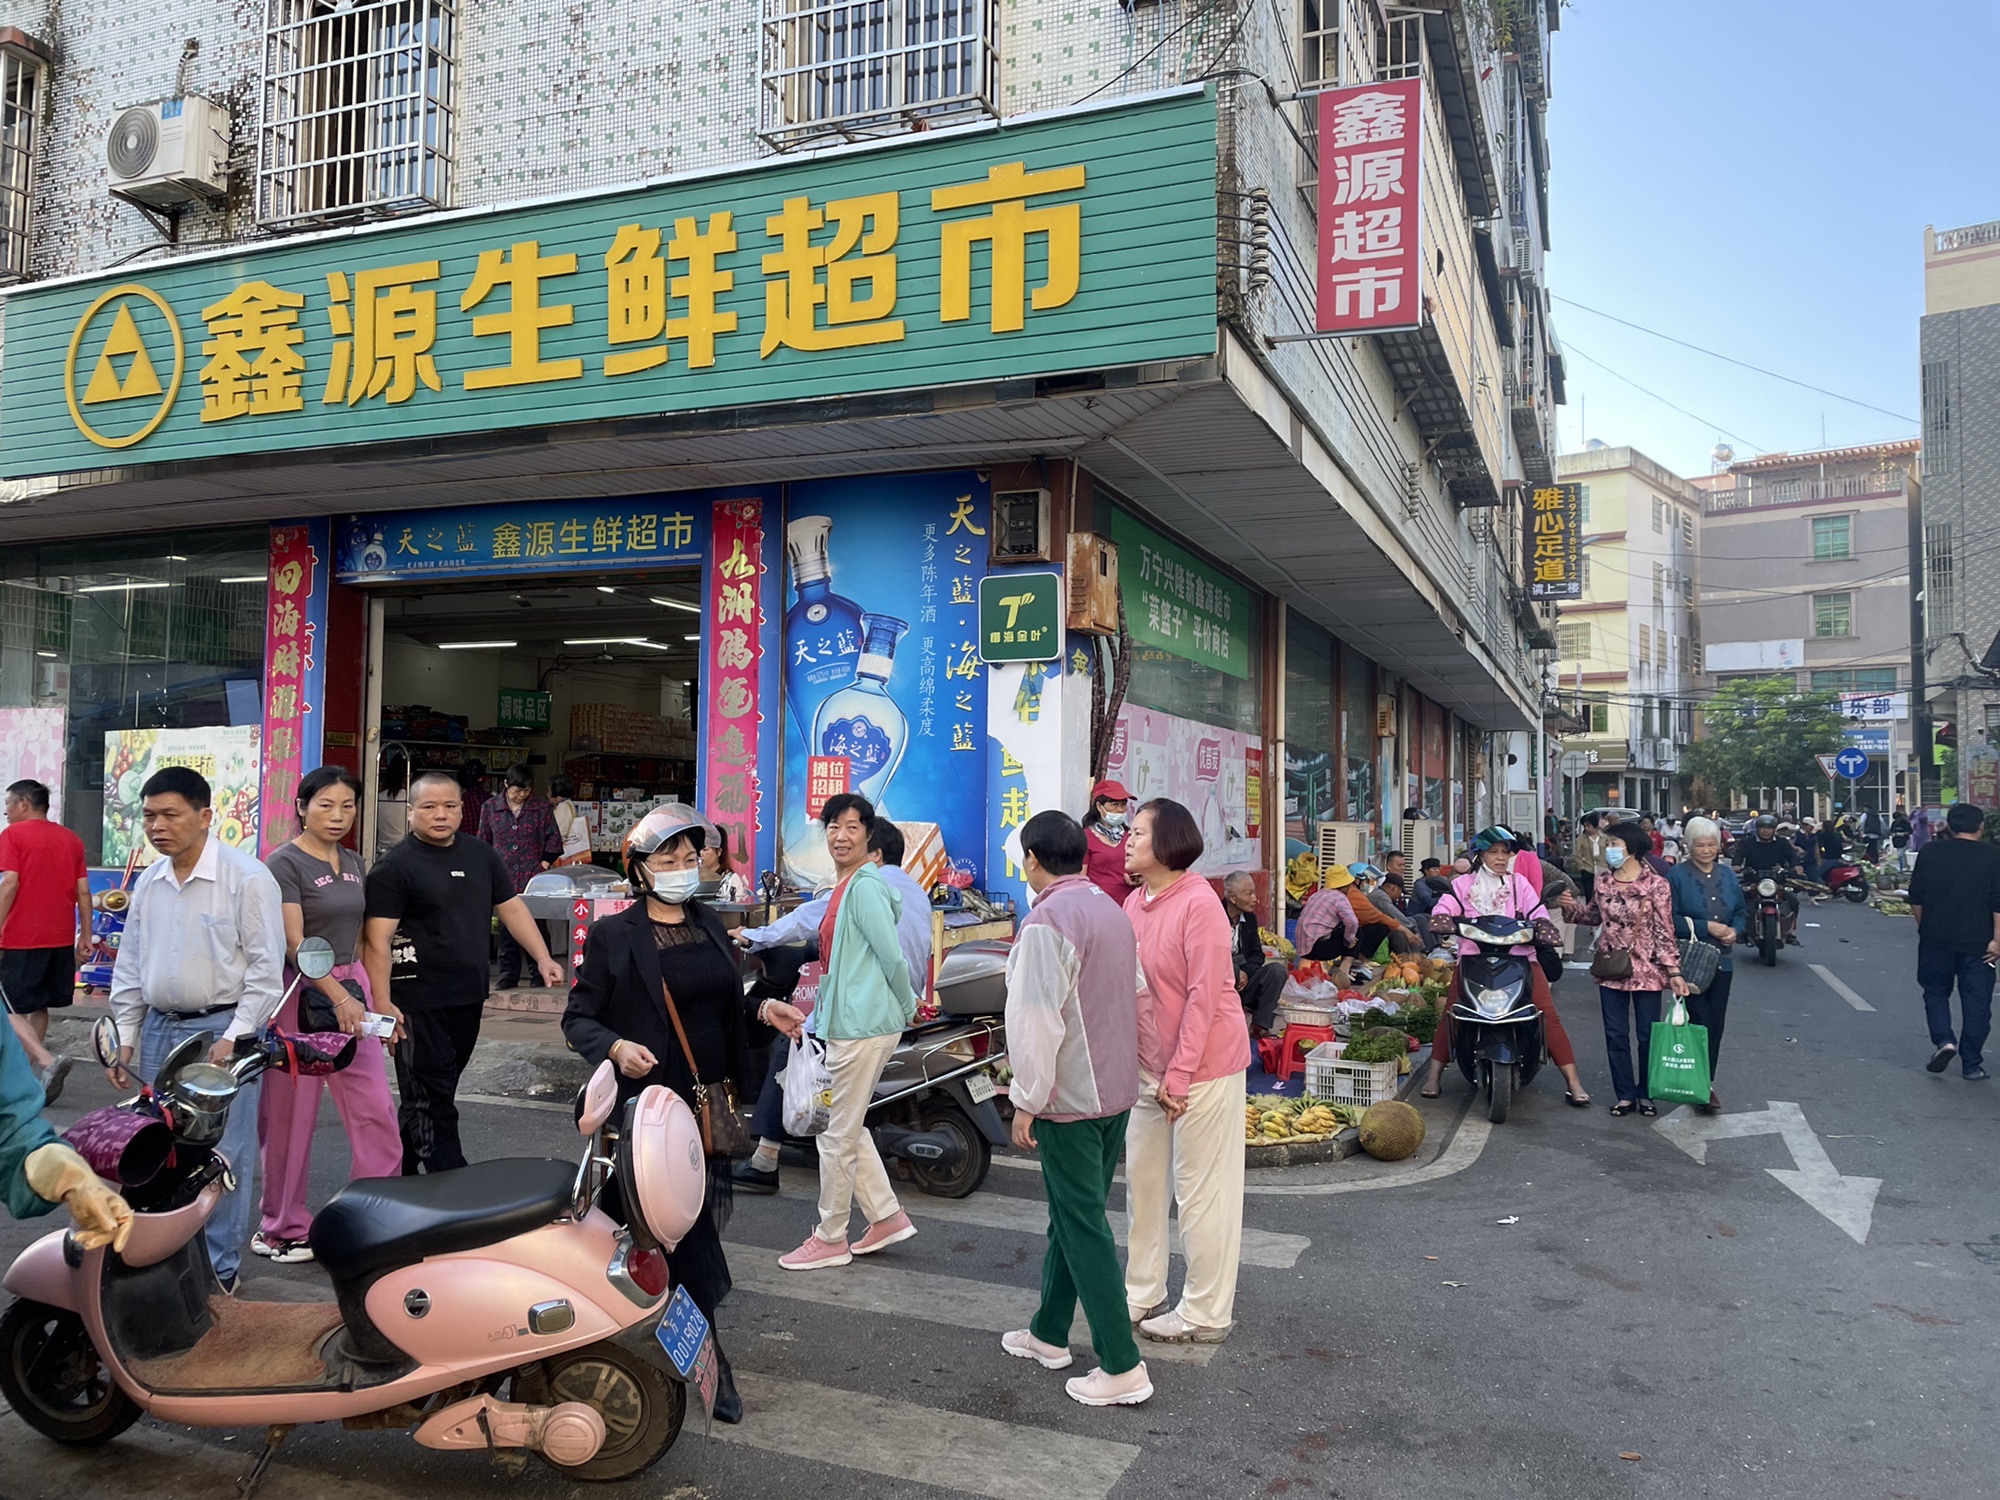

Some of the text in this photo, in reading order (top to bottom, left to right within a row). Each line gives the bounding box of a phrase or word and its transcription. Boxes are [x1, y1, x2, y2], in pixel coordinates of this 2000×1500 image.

[1331, 91, 1406, 320] 鑫源超市
[200, 160, 1086, 424] 鑫源生鲜超市
[491, 511, 695, 559] 鑫源生鲜超市
[1532, 487, 1565, 581] 雅心足道
[1568, 485, 1577, 580] 13976183912
[1140, 544, 1232, 622] 万宁兴隆新鑫源超市
[1532, 582, 1580, 595] 请上二楼
[916, 522, 939, 737] 更多陈年酒 更高绵柔度
[1193, 614, 1229, 660] 平价商店
[500, 695, 548, 722] 调味品区
[812, 761, 844, 778] 摊位
[812, 778, 843, 796] 招租
[1970, 759, 1998, 797] 夜宵
[669, 1305, 686, 1336] 万宁
[673, 1308, 704, 1367] 0015028
